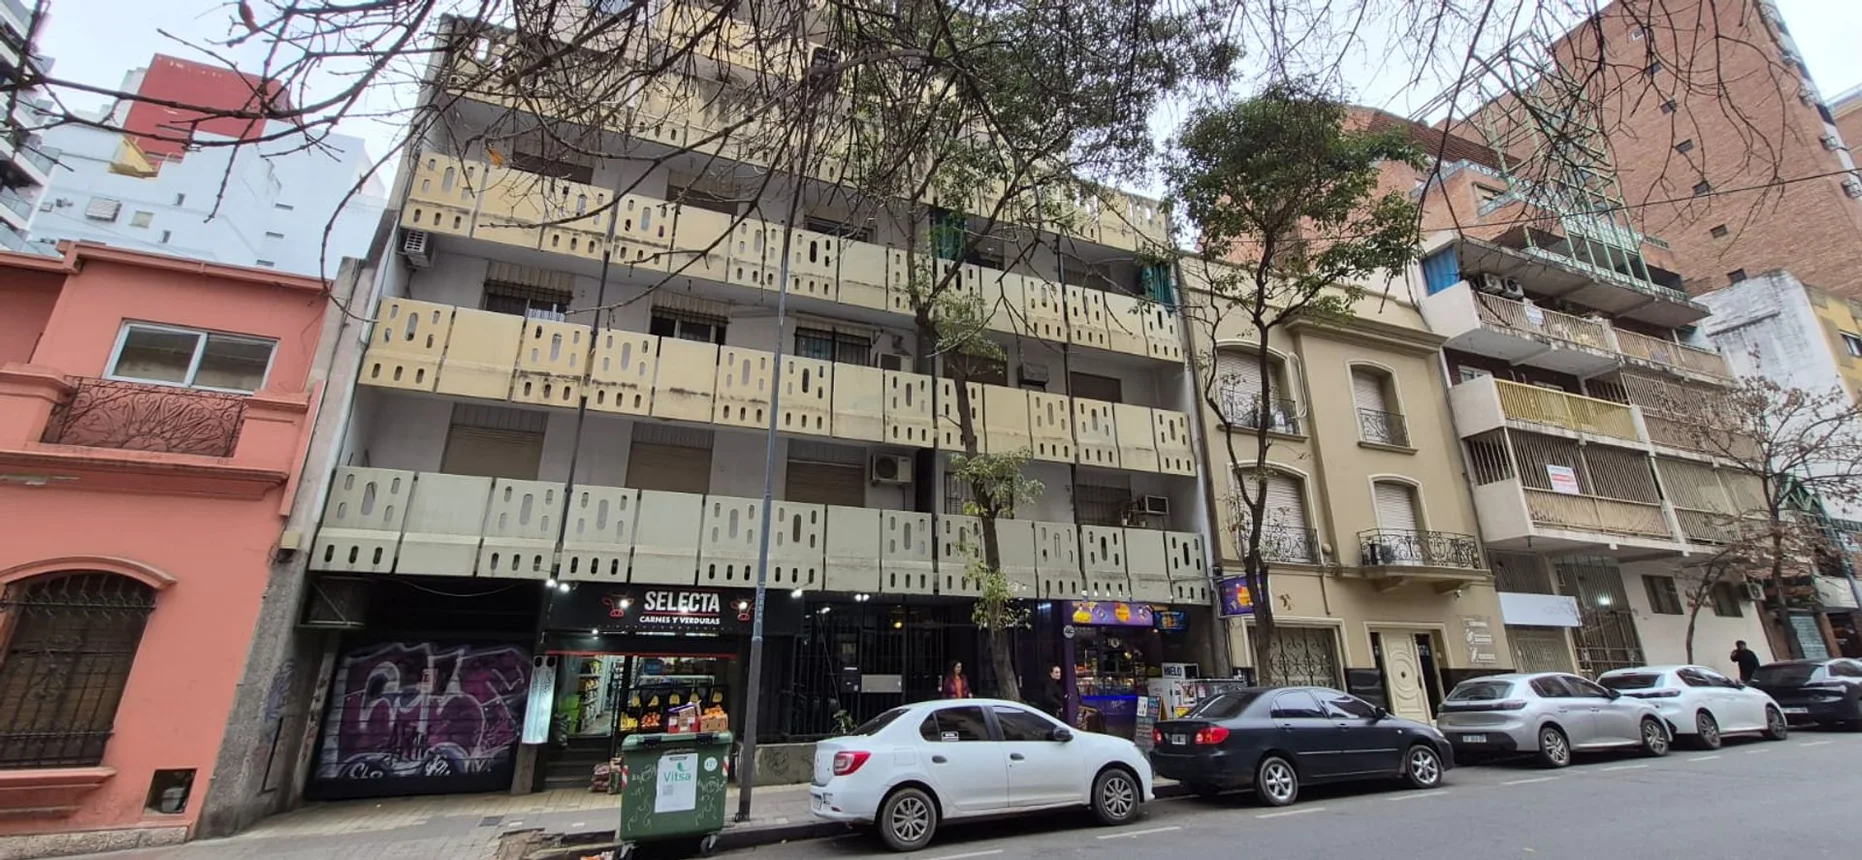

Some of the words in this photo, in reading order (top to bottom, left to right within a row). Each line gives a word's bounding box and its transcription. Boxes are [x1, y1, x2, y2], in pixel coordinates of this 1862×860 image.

[644, 590, 720, 613] SELECTA
[639, 615, 671, 624] CARNES
[672, 616, 679, 624] Y
[680, 617, 720, 625] VERDURAS
[663, 771, 692, 782] Vitsa
